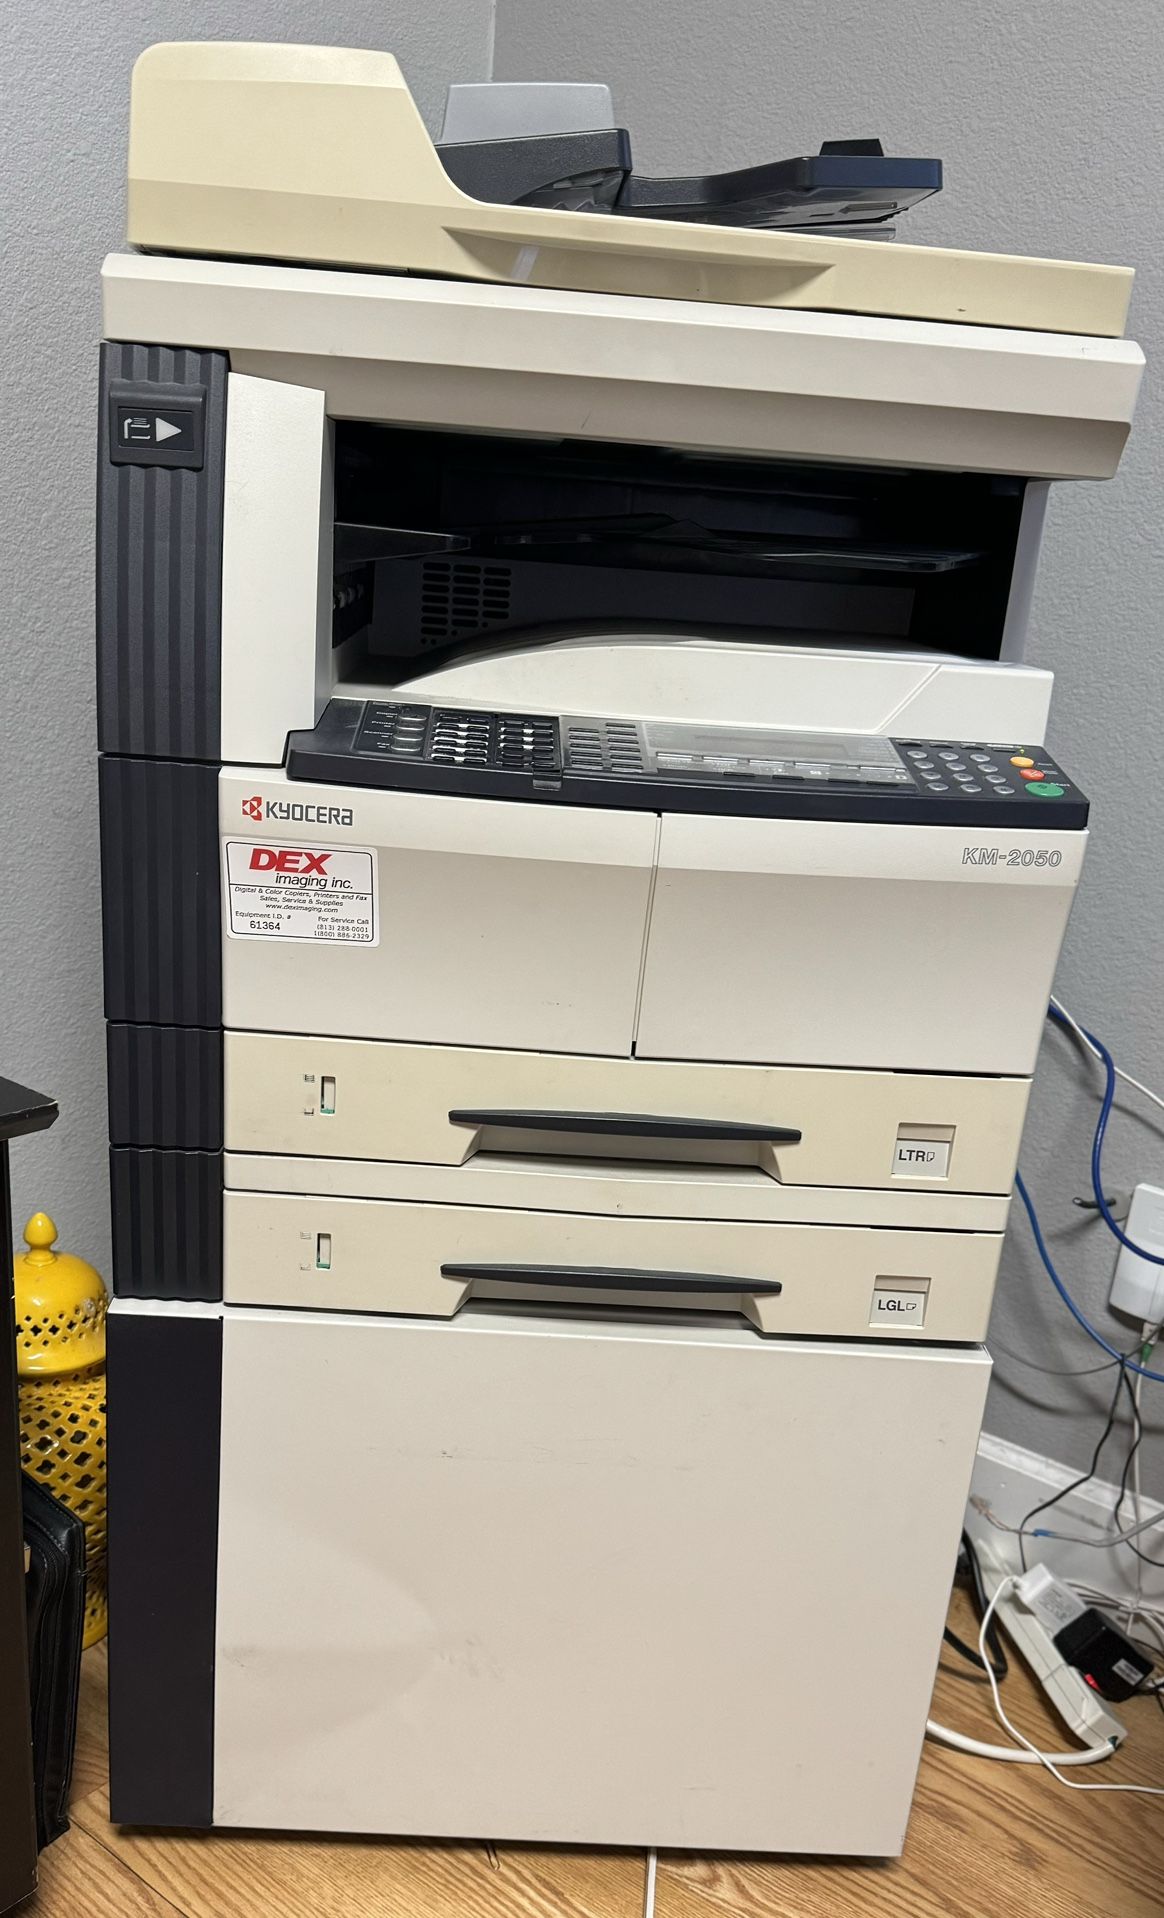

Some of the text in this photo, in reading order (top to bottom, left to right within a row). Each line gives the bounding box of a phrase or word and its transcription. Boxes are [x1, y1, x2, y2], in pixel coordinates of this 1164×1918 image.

[265, 801, 354, 827] KYOCERA
[249, 848, 332, 875] DEX
[961, 847, 1062, 867] KM-2050
[275, 873, 353, 890] imaging inc.
[234, 886, 257, 894] Digital
[264, 888, 283, 896] Color
[284, 889, 312, 898] Copiers,
[313, 891, 340, 900] Printers
[259, 895, 280, 903] Sales,
[281, 896, 307, 905] Service
[315, 899, 344, 907] Supplies
[235, 910, 271, 919] Equipment
[265, 903, 339, 913] www.deximaging.com
[249, 920, 281, 931] 61364
[330, 916, 355, 924] Service
[316, 923, 335, 931] (813)
[898, 1148, 926, 1162] LTR
[877, 1299, 906, 1312] LGL
